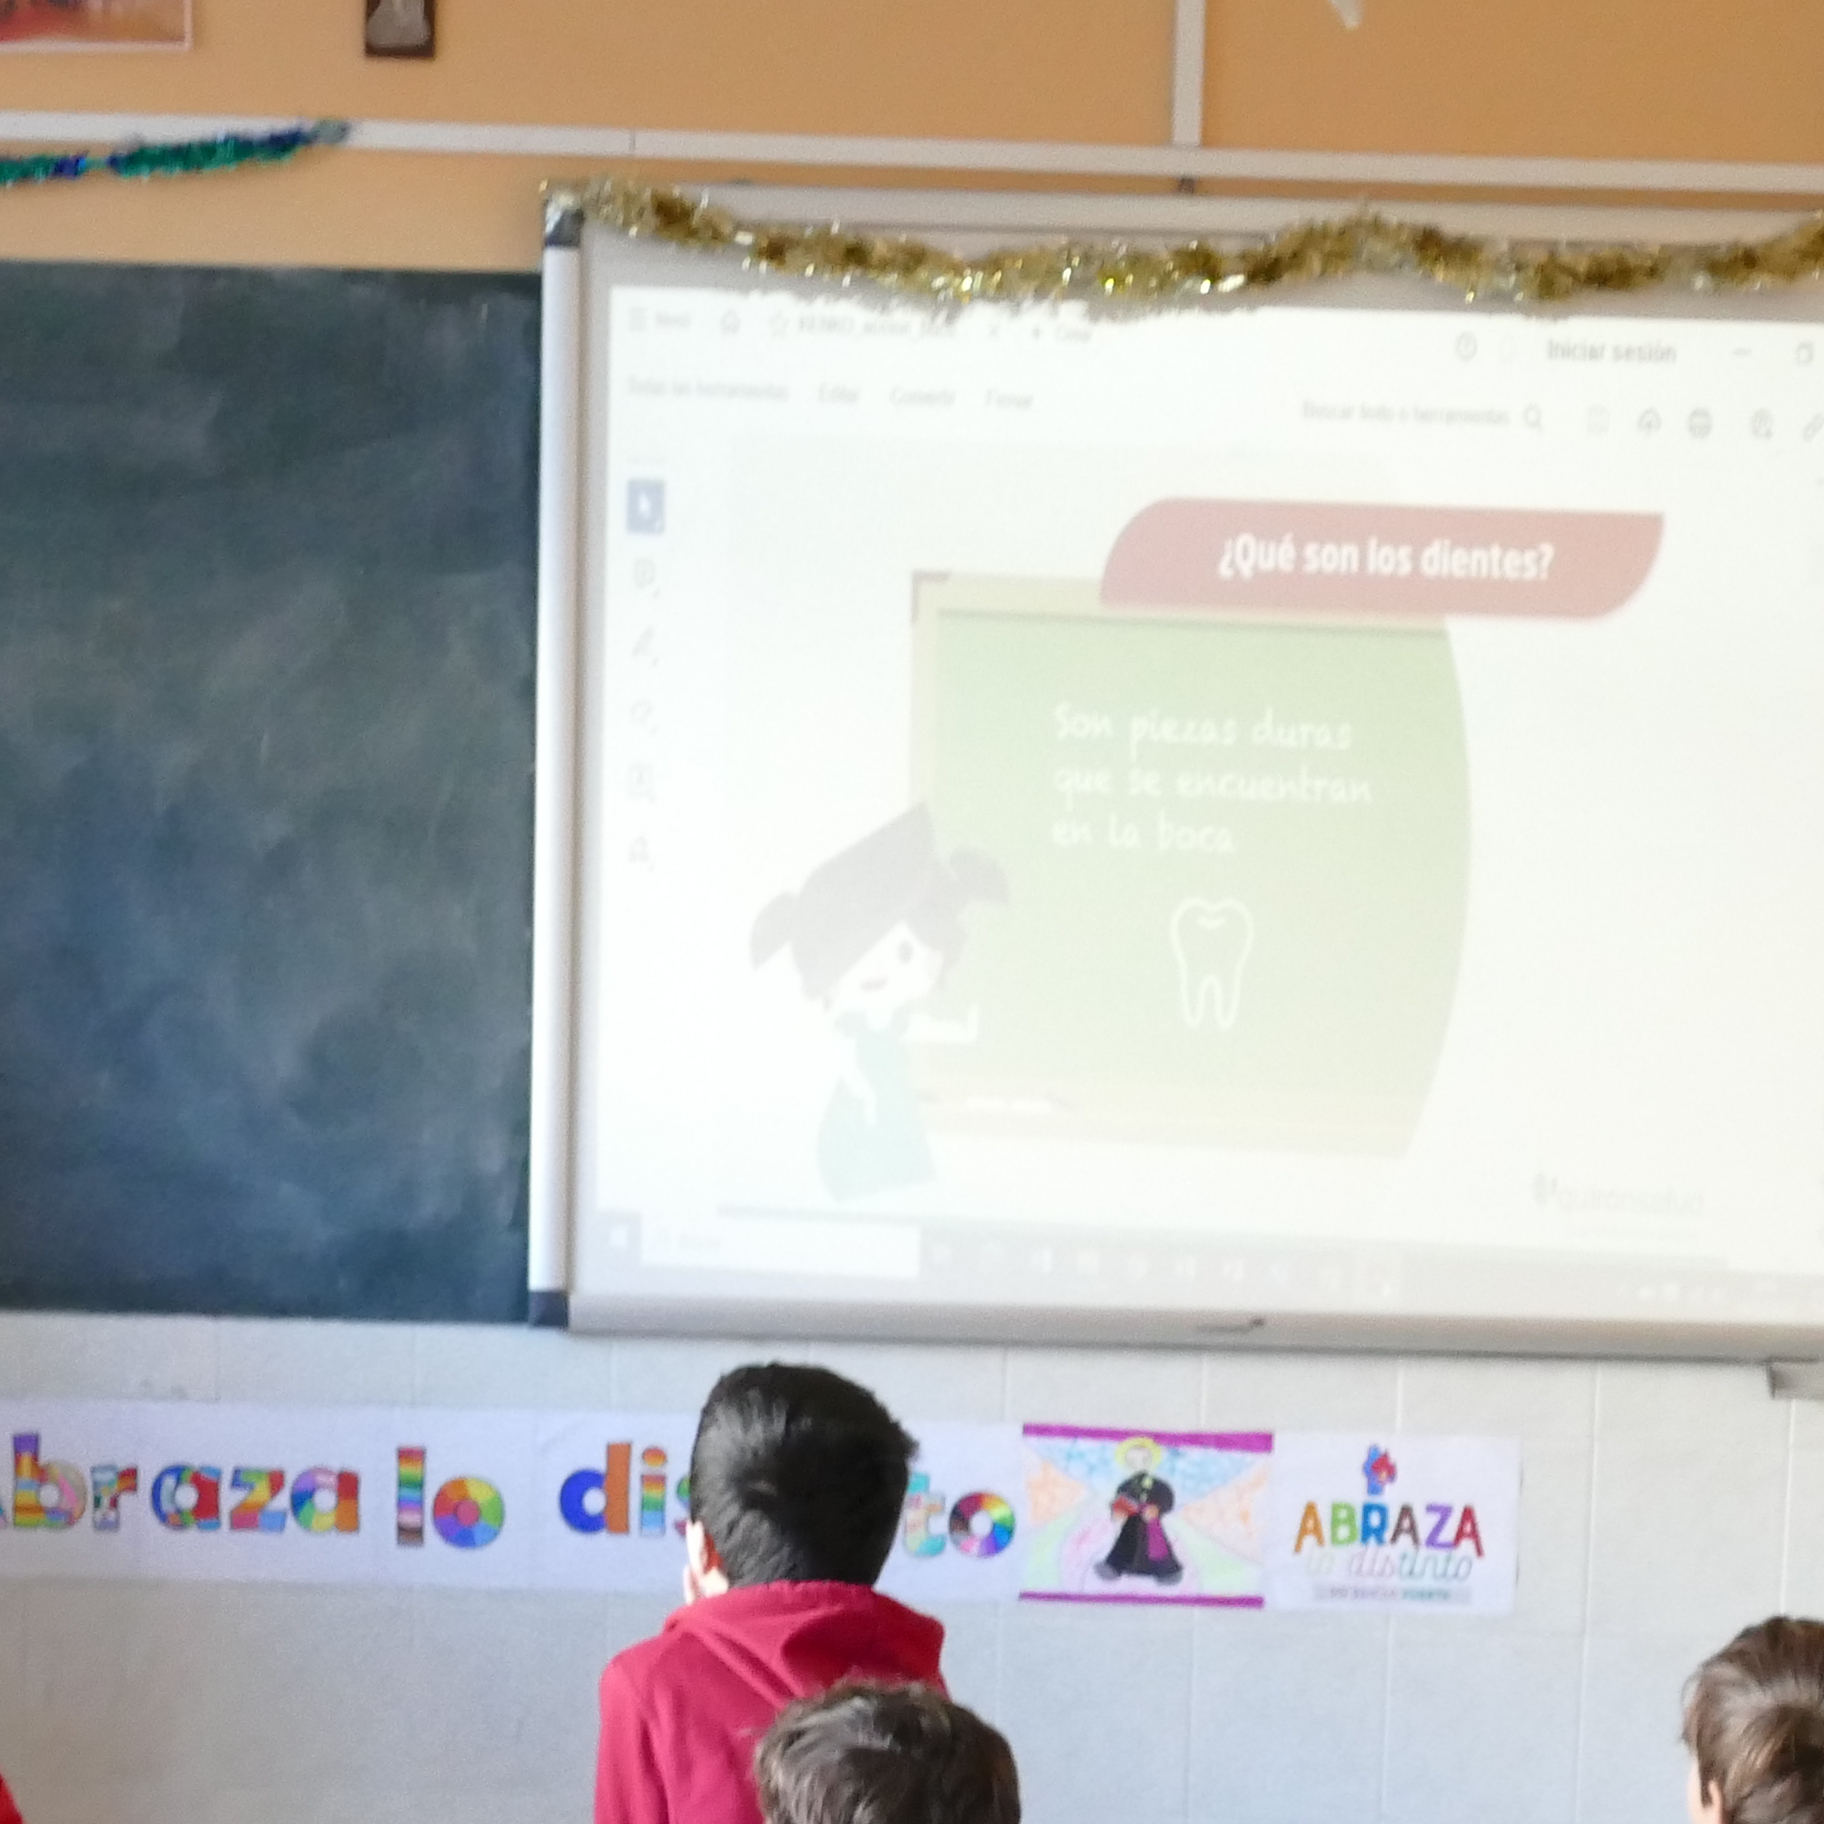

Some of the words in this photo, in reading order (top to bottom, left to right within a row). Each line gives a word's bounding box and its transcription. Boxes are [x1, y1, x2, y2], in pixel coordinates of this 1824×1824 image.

[1545, 336, 1605, 363] Iniciar
[1611, 337, 1677, 365] sesión
[1218, 530, 1295, 581] ¿Qué
[1303, 541, 1361, 576] son
[1367, 536, 1414, 577] los
[1420, 538, 1555, 582] dientes?
[1053, 699, 1113, 741] Son
[1128, 707, 1238, 764] piezas
[1250, 705, 1354, 751] duras
[1053, 766, 1113, 812] que
[1127, 766, 1163, 798] se
[1175, 762, 1374, 805] encuentran
[1050, 818, 1094, 848] en
[1109, 811, 1143, 850] la
[1157, 806, 1237, 853] boca
[394, 1444, 507, 1551] lo
[556, 1441, 1018, 1560] dito
[1293, 1500, 1485, 1558] ABRAZA
